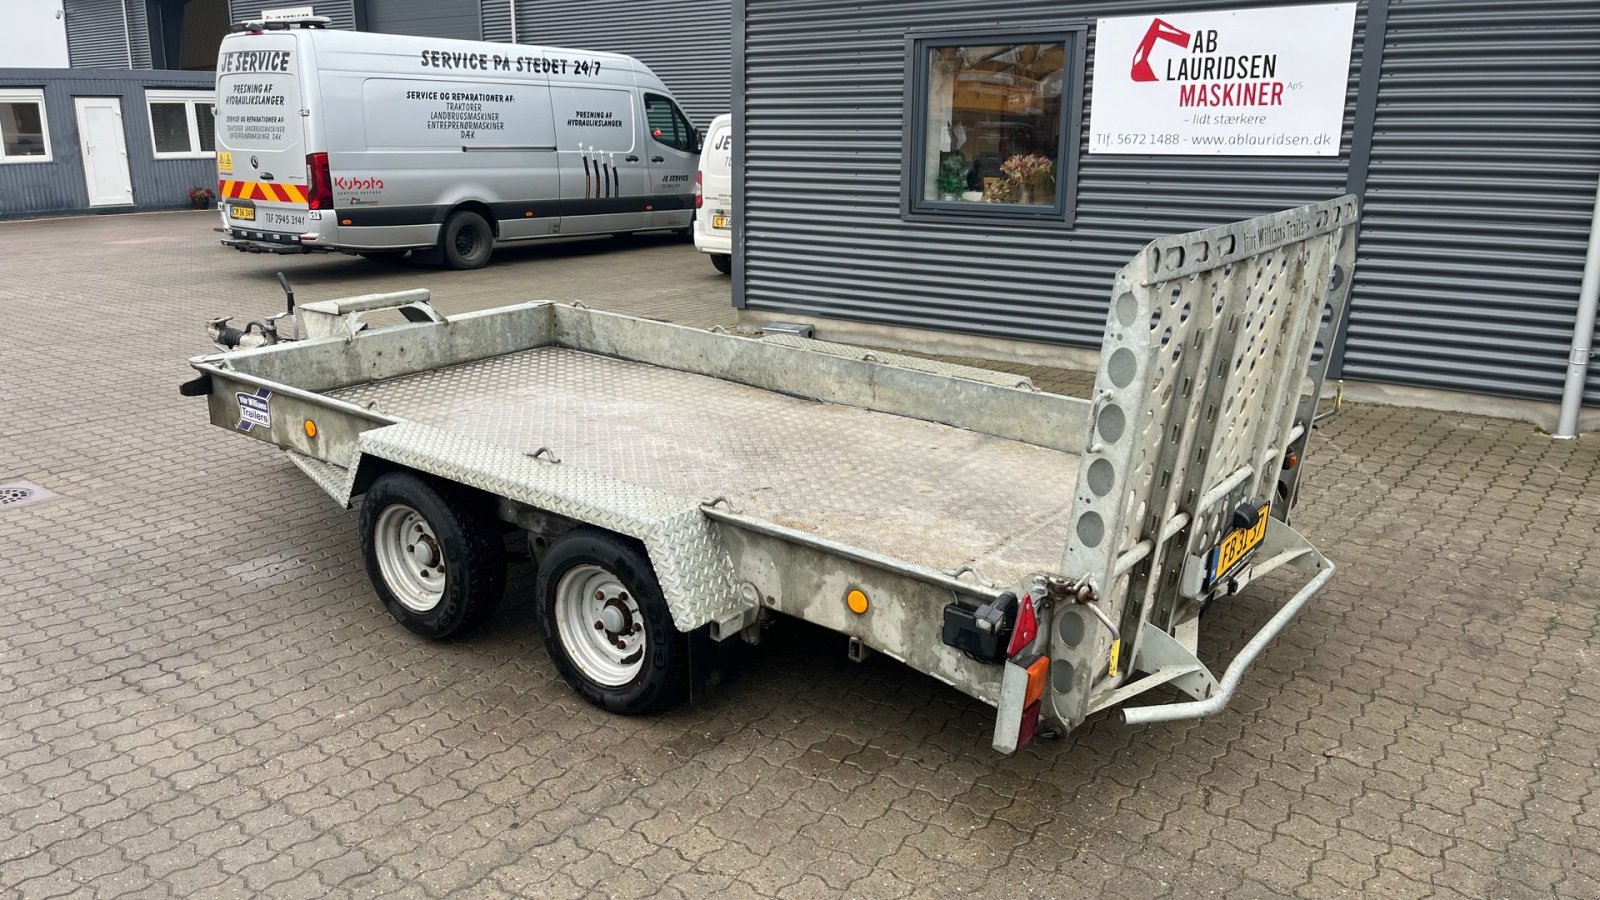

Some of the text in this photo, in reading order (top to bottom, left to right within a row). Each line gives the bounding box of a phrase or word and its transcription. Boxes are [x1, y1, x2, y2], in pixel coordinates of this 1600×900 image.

[1192, 29, 1218, 54] AB
[221, 51, 291, 72] JE SERVICE
[421, 50, 488, 71] SERVICE
[516, 56, 568, 74] STEDET
[573, 59, 601, 77] 24/7
[1166, 54, 1277, 81] LAURIDSEN
[233, 84, 273, 94] PRESNING AF
[1179, 81, 1304, 107] MASKINER ApS
[406, 91, 438, 100] SERVICE
[439, 92, 450, 101] OG
[451, 93, 504, 102] REPARATIONER
[446, 102, 482, 112] TRAKTORER
[430, 111, 500, 121] LANDBRUGSMASKINER
[575, 110, 613, 119] PRESNING AF
[1192, 113, 1210, 125] lidt
[1213, 113, 1267, 125] stærkere
[427, 120, 505, 131] ENTREPRENØRMASKINER
[567, 119, 623, 128] HYDRAULIKSLANGER
[460, 130, 476, 140] DÆK
[1096, 133, 1114, 147] Tlf.
[1117, 133, 1147, 145] 5672
[1150, 133, 1180, 145] 1488
[1191, 133, 1332, 147] www.ablauridsen.dk
[334, 176, 384, 190] Kubota
[669, 174, 689, 182] SERVICE
[275, 214, 290, 225] 2945
[291, 215, 305, 226] 3141
[241, 406, 268, 423] Trailers
